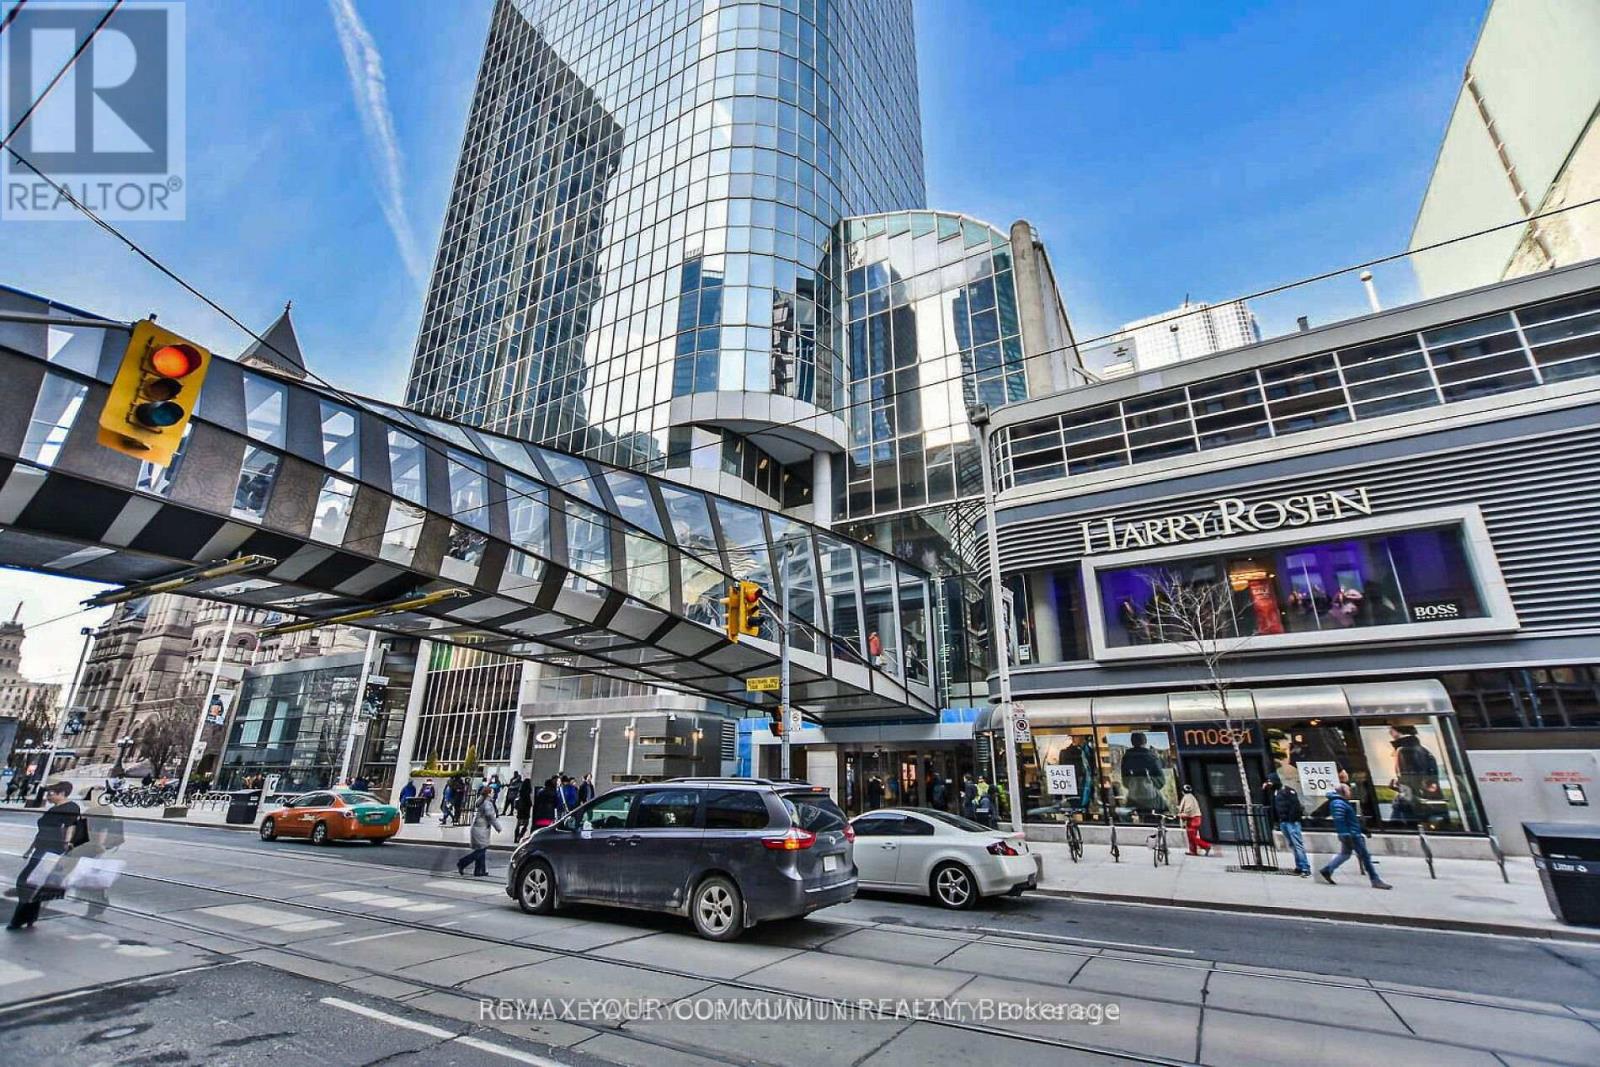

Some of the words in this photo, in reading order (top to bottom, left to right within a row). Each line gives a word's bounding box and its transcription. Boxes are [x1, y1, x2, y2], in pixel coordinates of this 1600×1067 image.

[1078, 510, 1213, 554] HARRY
[1214, 486, 1372, 535] ROSEN
[1414, 603, 1458, 616] BOSS
[1050, 769, 1072, 777] SALE
[1303, 766, 1331, 775] SALE
